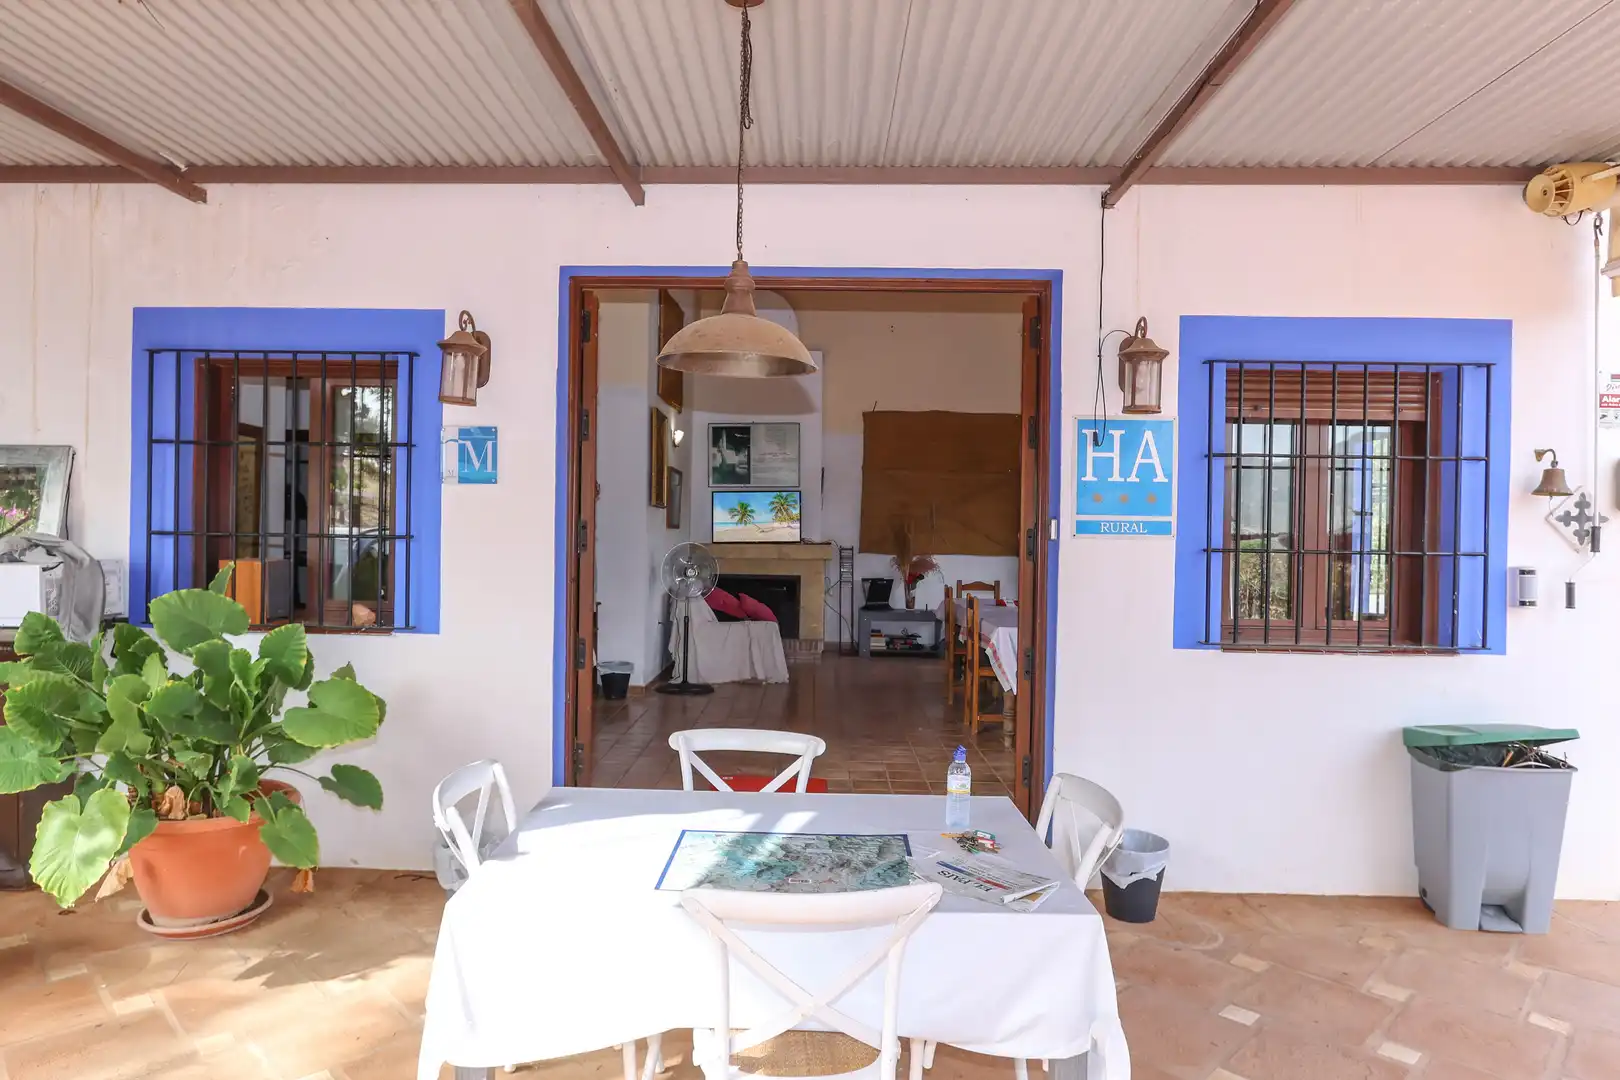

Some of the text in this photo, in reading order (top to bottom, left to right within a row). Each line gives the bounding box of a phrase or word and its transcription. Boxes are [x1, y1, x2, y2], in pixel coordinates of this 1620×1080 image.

[459, 440, 497, 472] M
[1081, 429, 1168, 482] HA
[1100, 522, 1148, 533] RURAL
